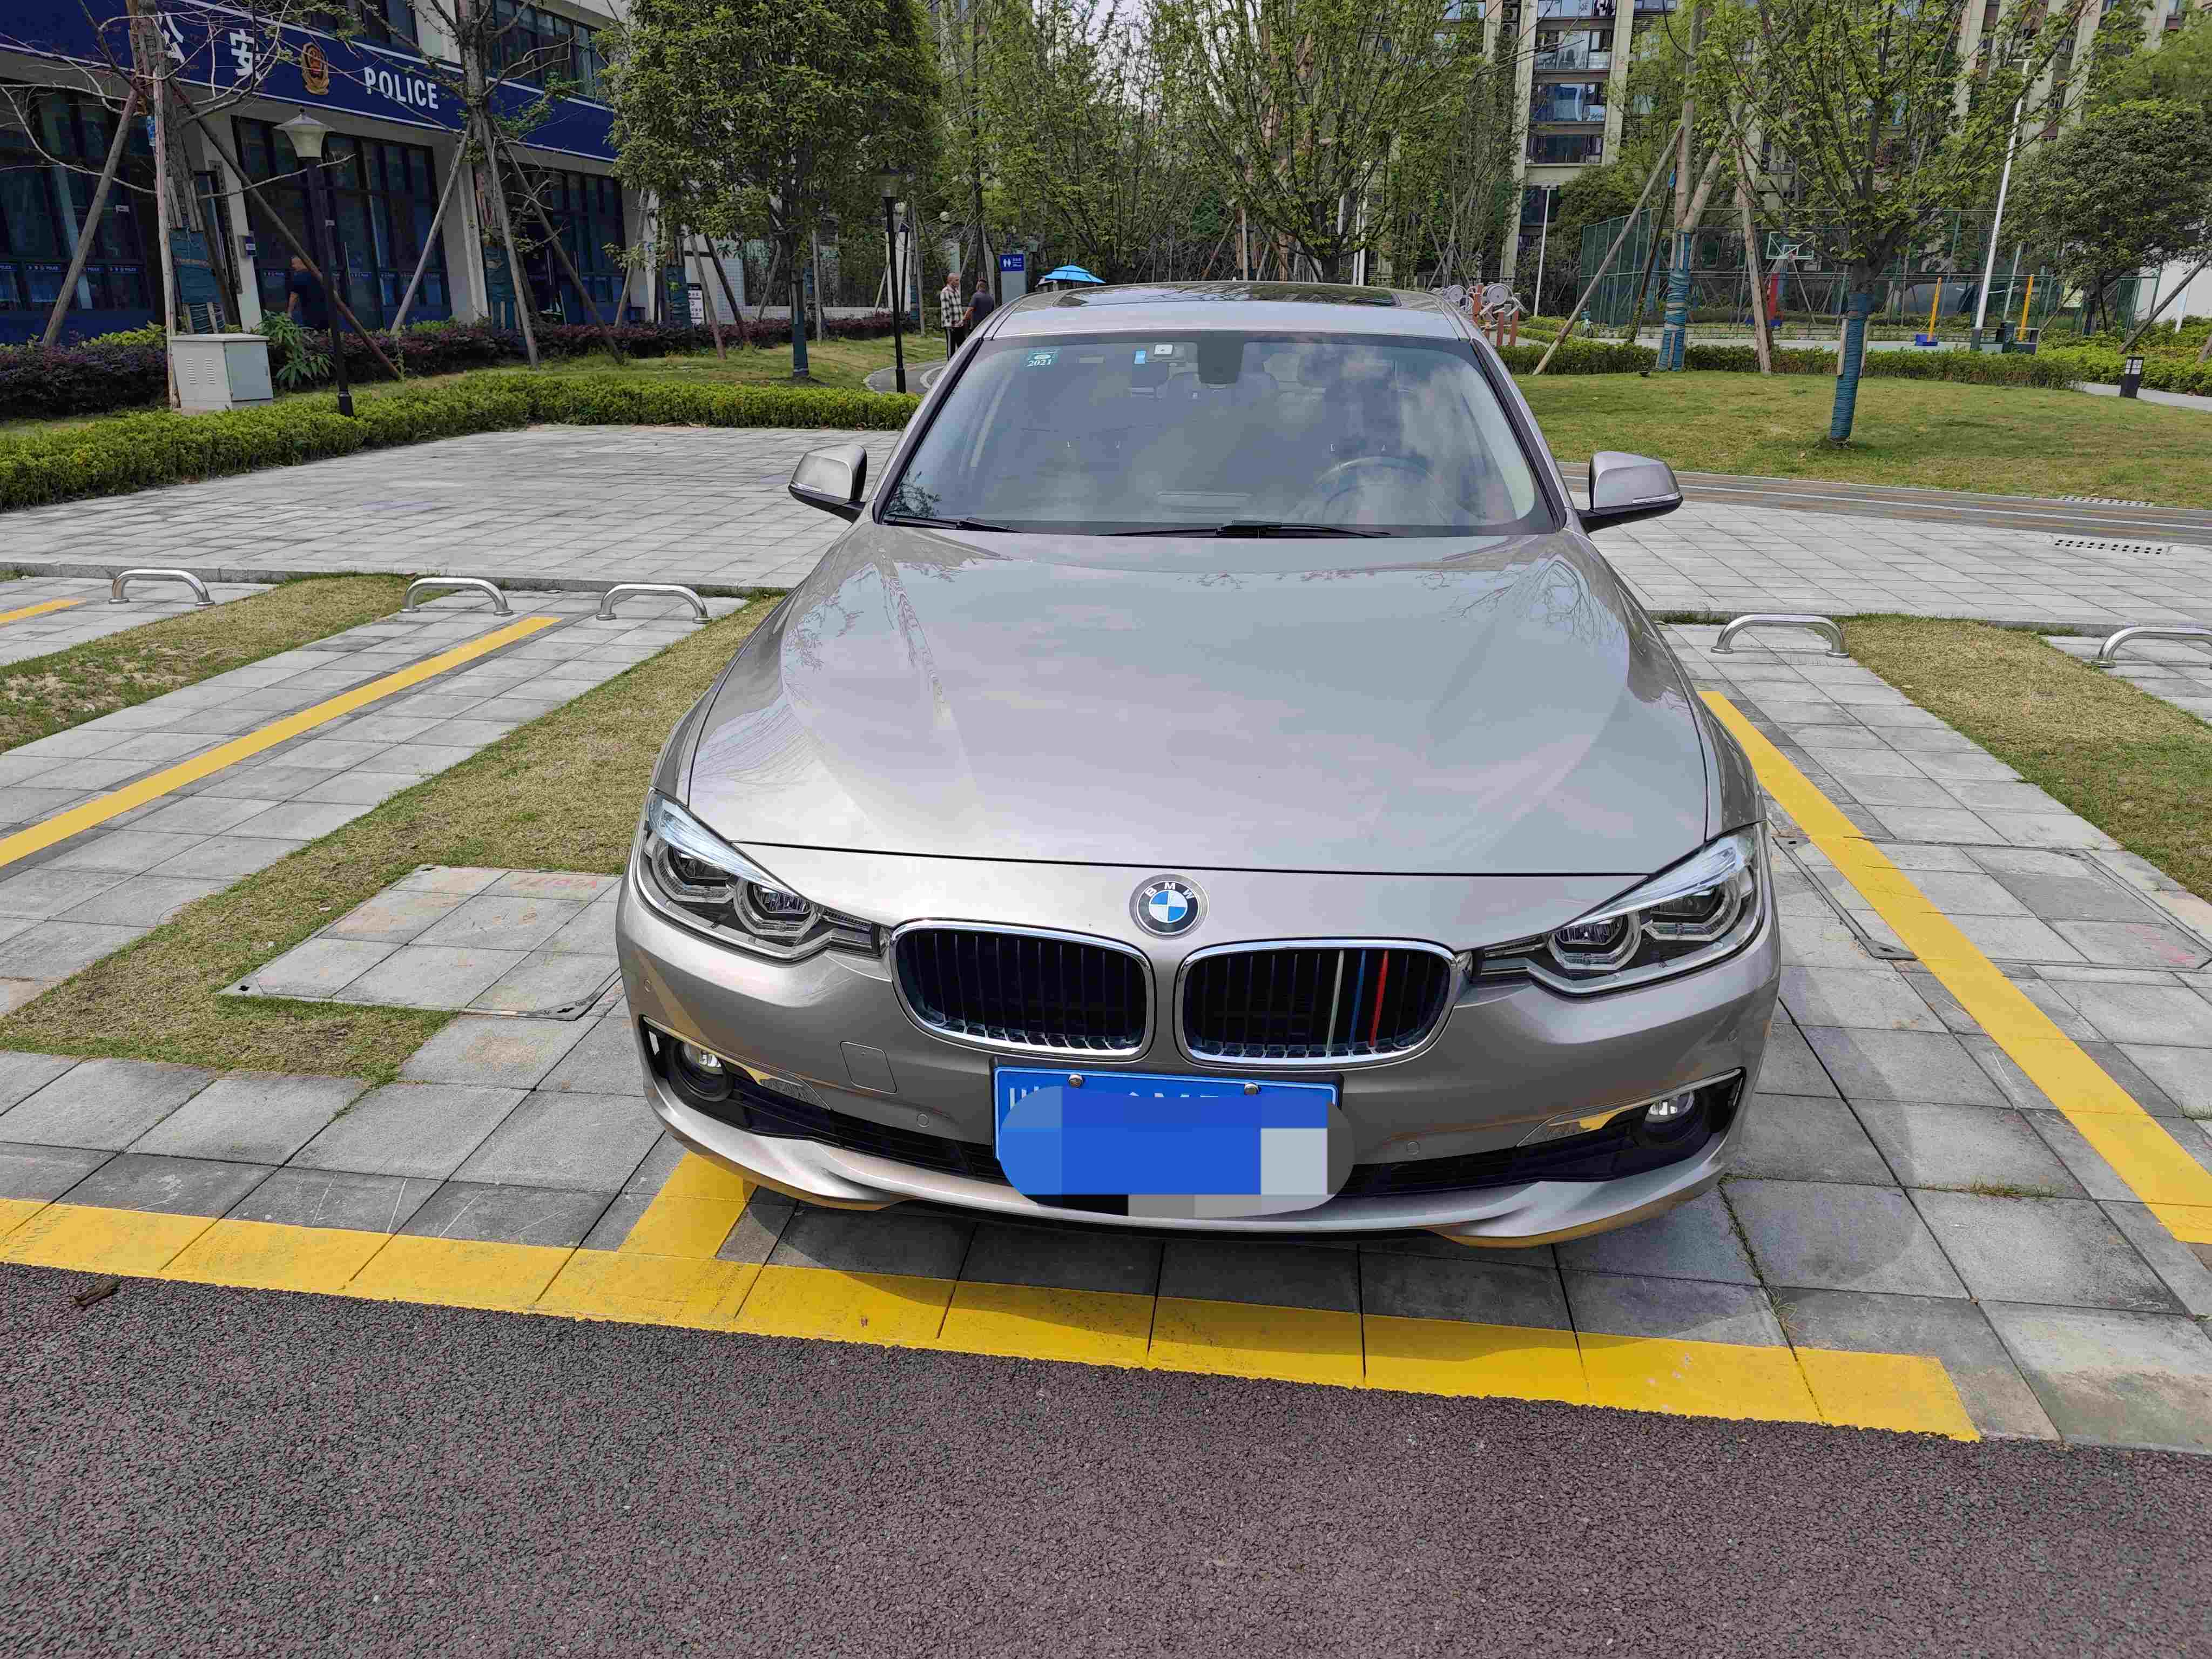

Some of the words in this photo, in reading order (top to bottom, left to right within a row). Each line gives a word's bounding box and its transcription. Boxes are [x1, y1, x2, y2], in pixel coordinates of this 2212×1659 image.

[363, 67, 439, 109] POLICE
[1027, 359, 1052, 367] 2021
[1144, 882, 1196, 899] BMW
